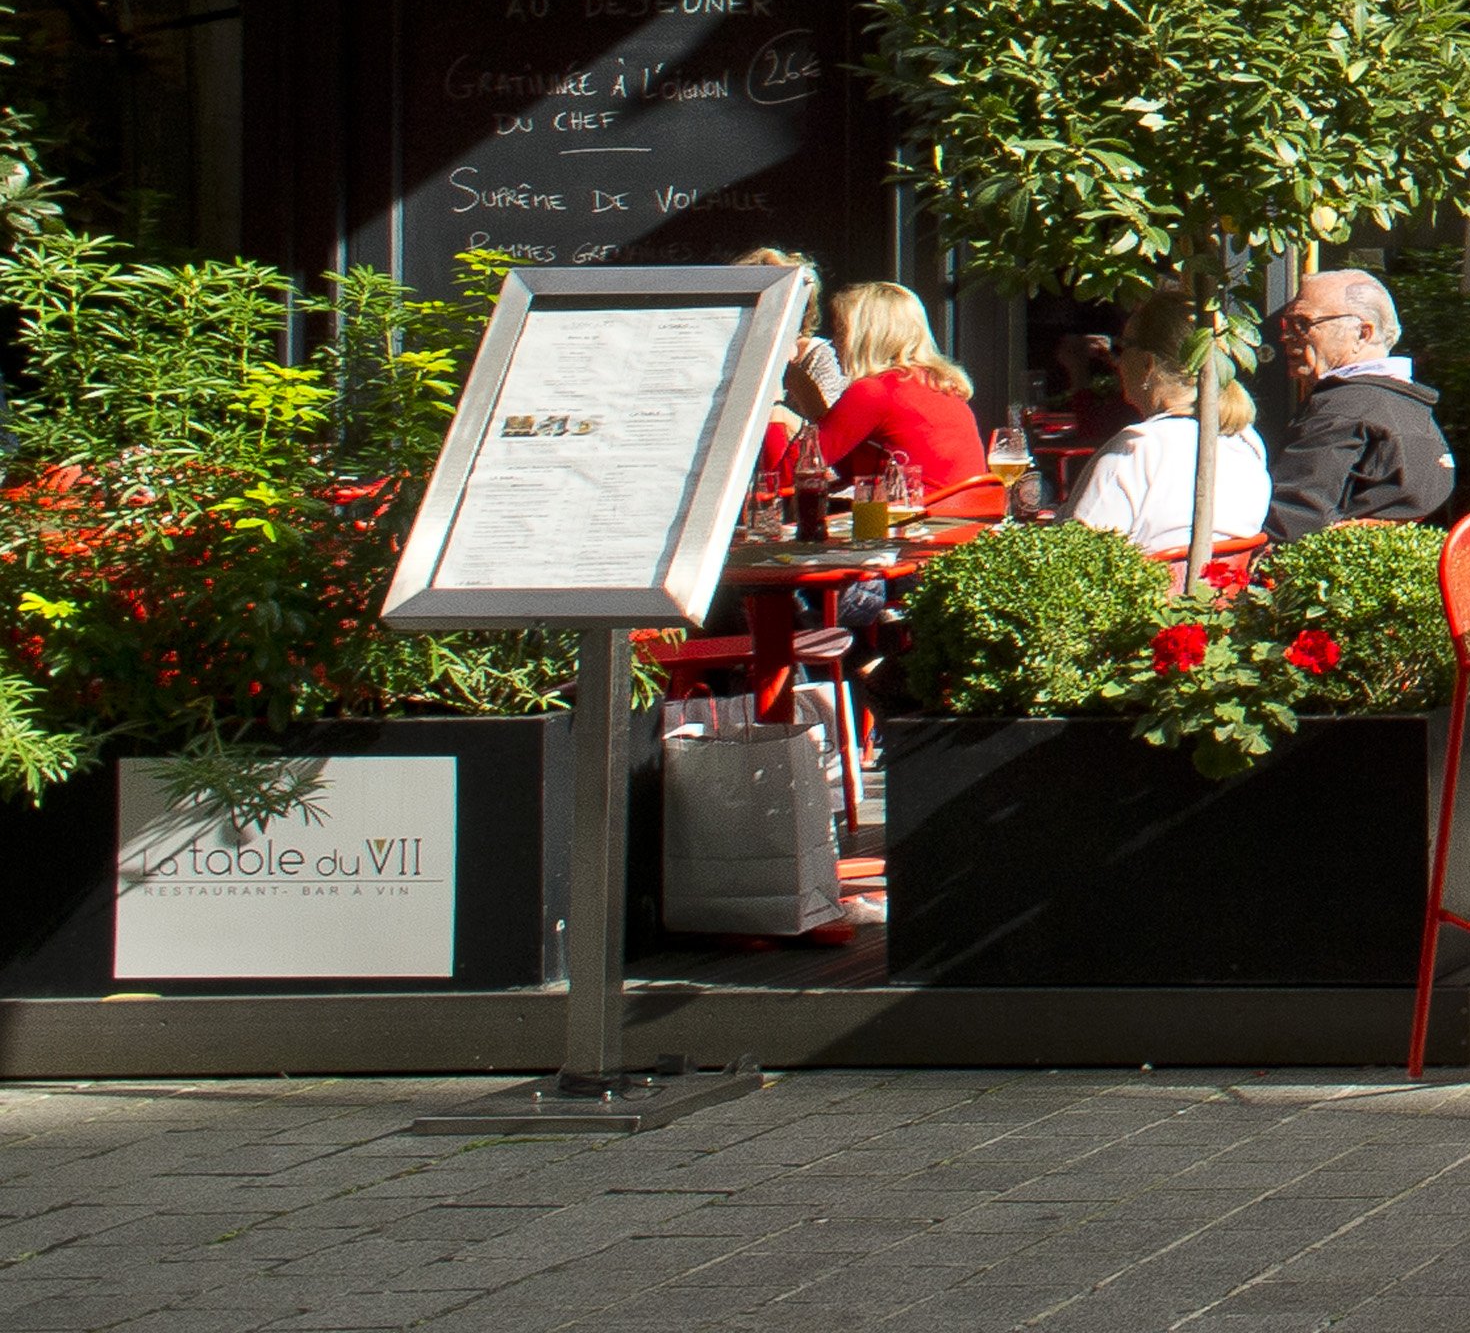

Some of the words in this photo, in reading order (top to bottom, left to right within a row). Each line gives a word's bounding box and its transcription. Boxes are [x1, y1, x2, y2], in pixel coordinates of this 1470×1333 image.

[494, 112, 533, 136] DU
[553, 110, 621, 132] CHEF
[448, 165, 568, 214] SUPRÊME
[591, 189, 630, 214] DE
[142, 850, 178, 878] La
[188, 838, 305, 877] table
[316, 848, 361, 877] du
[366, 837, 423, 877] VII
[301, 886, 340, 897] BAR
[376, 886, 410, 897] VIN
